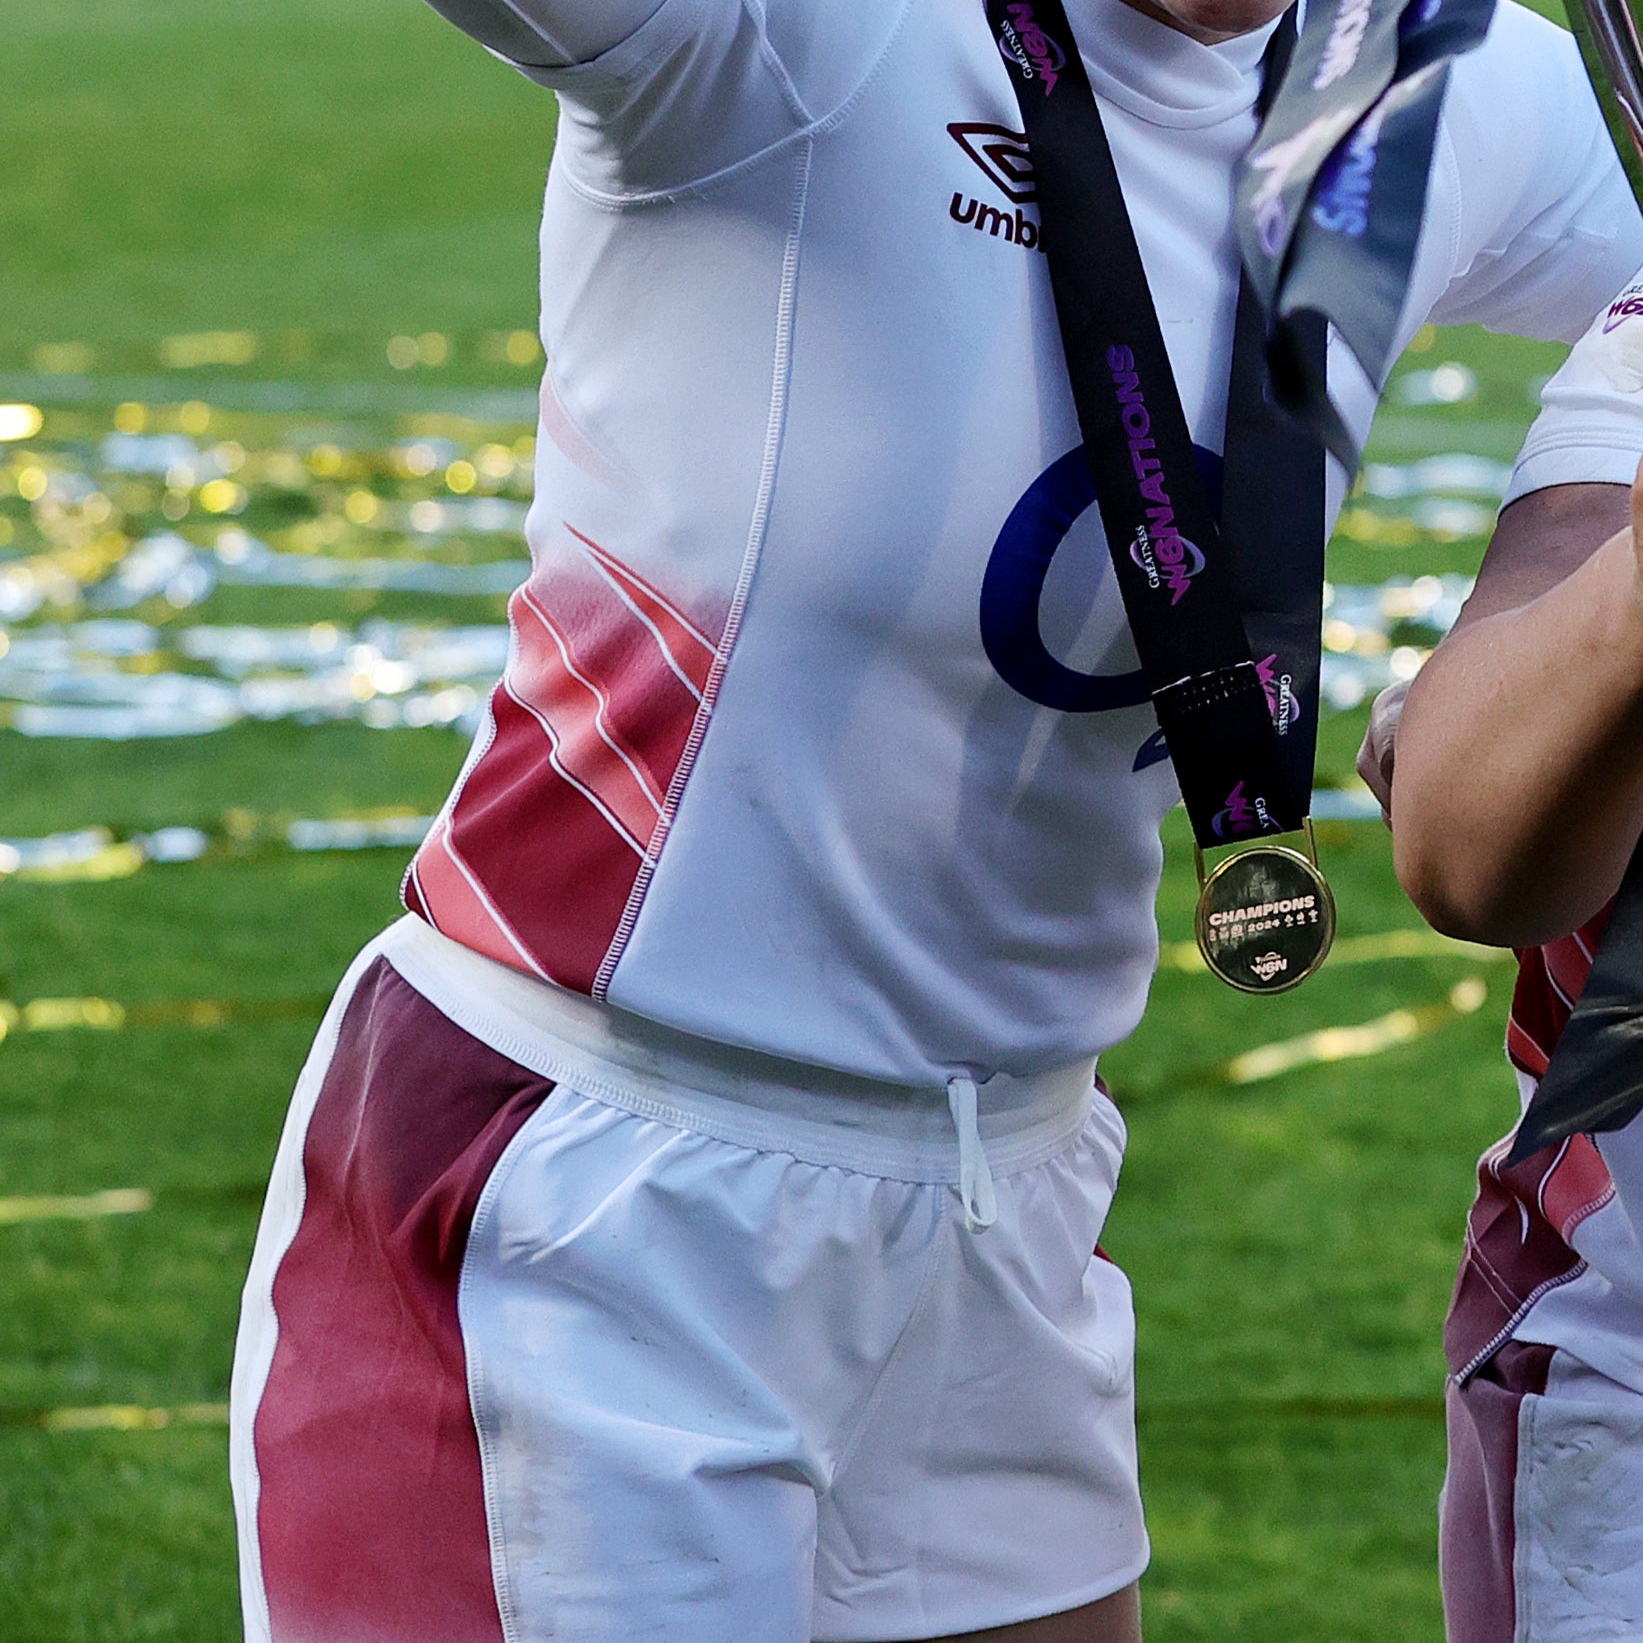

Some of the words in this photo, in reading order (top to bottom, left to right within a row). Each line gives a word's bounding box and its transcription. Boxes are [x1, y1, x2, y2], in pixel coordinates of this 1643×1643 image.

[1106, 344, 1192, 606] W6NATIONS
[1209, 895, 1315, 926] CHAMPIONS
[1247, 918, 1280, 932] 2024
